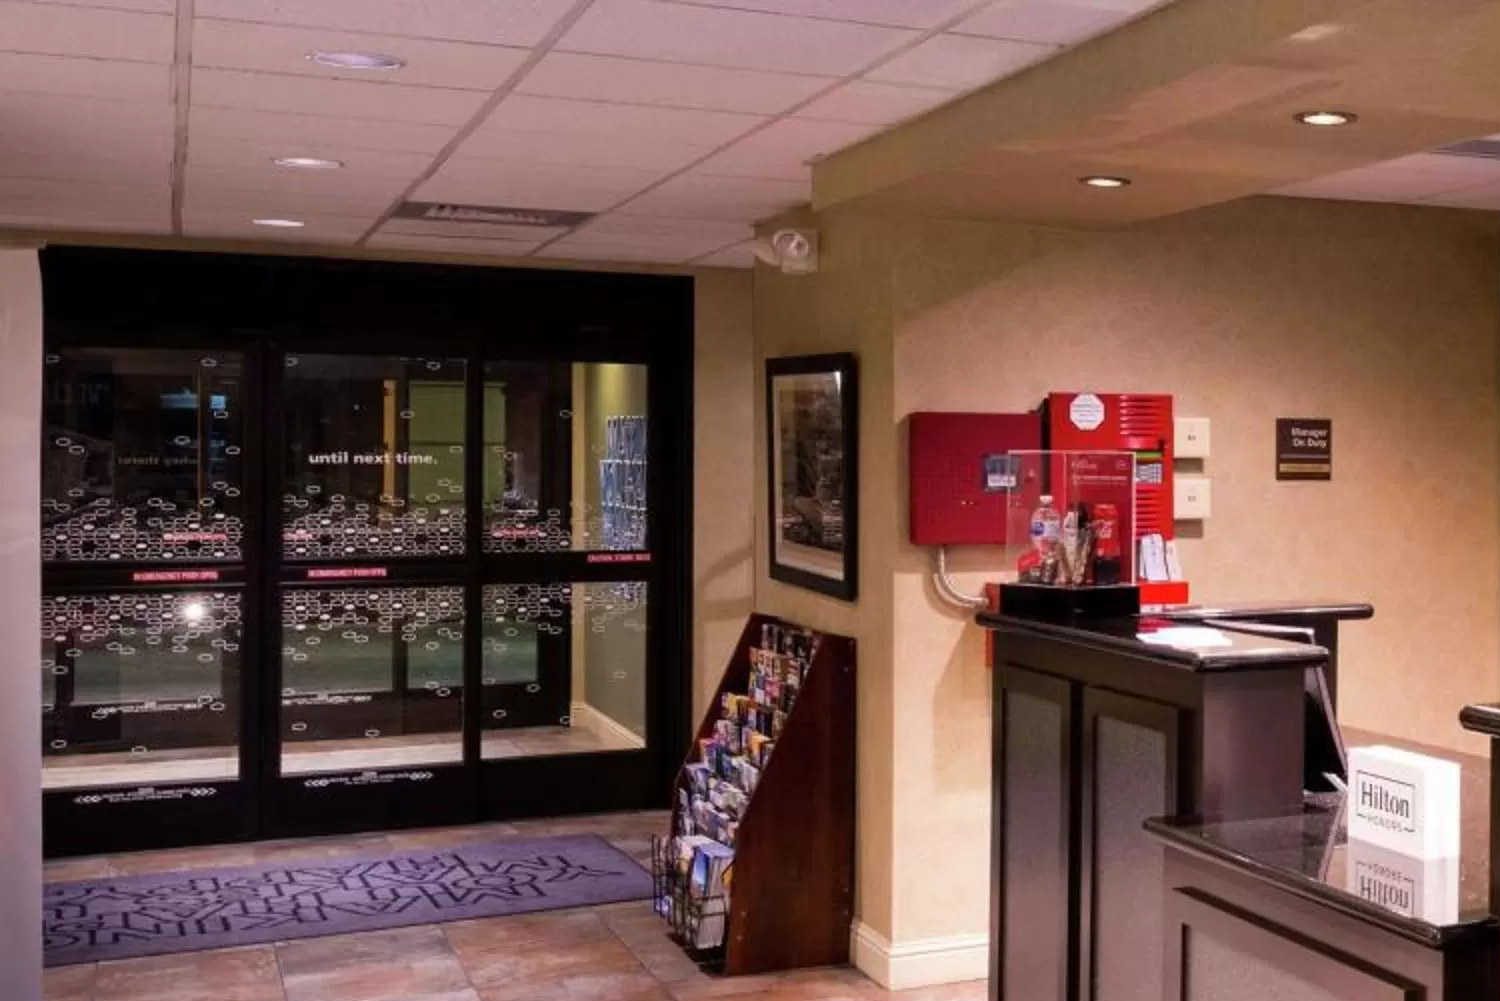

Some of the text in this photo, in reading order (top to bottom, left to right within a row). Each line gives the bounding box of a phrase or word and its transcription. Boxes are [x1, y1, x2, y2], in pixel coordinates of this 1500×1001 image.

[1291, 427, 1328, 438] Manager
[308, 451, 438, 465] until next time.
[1361, 781, 1410, 819] Hilton
